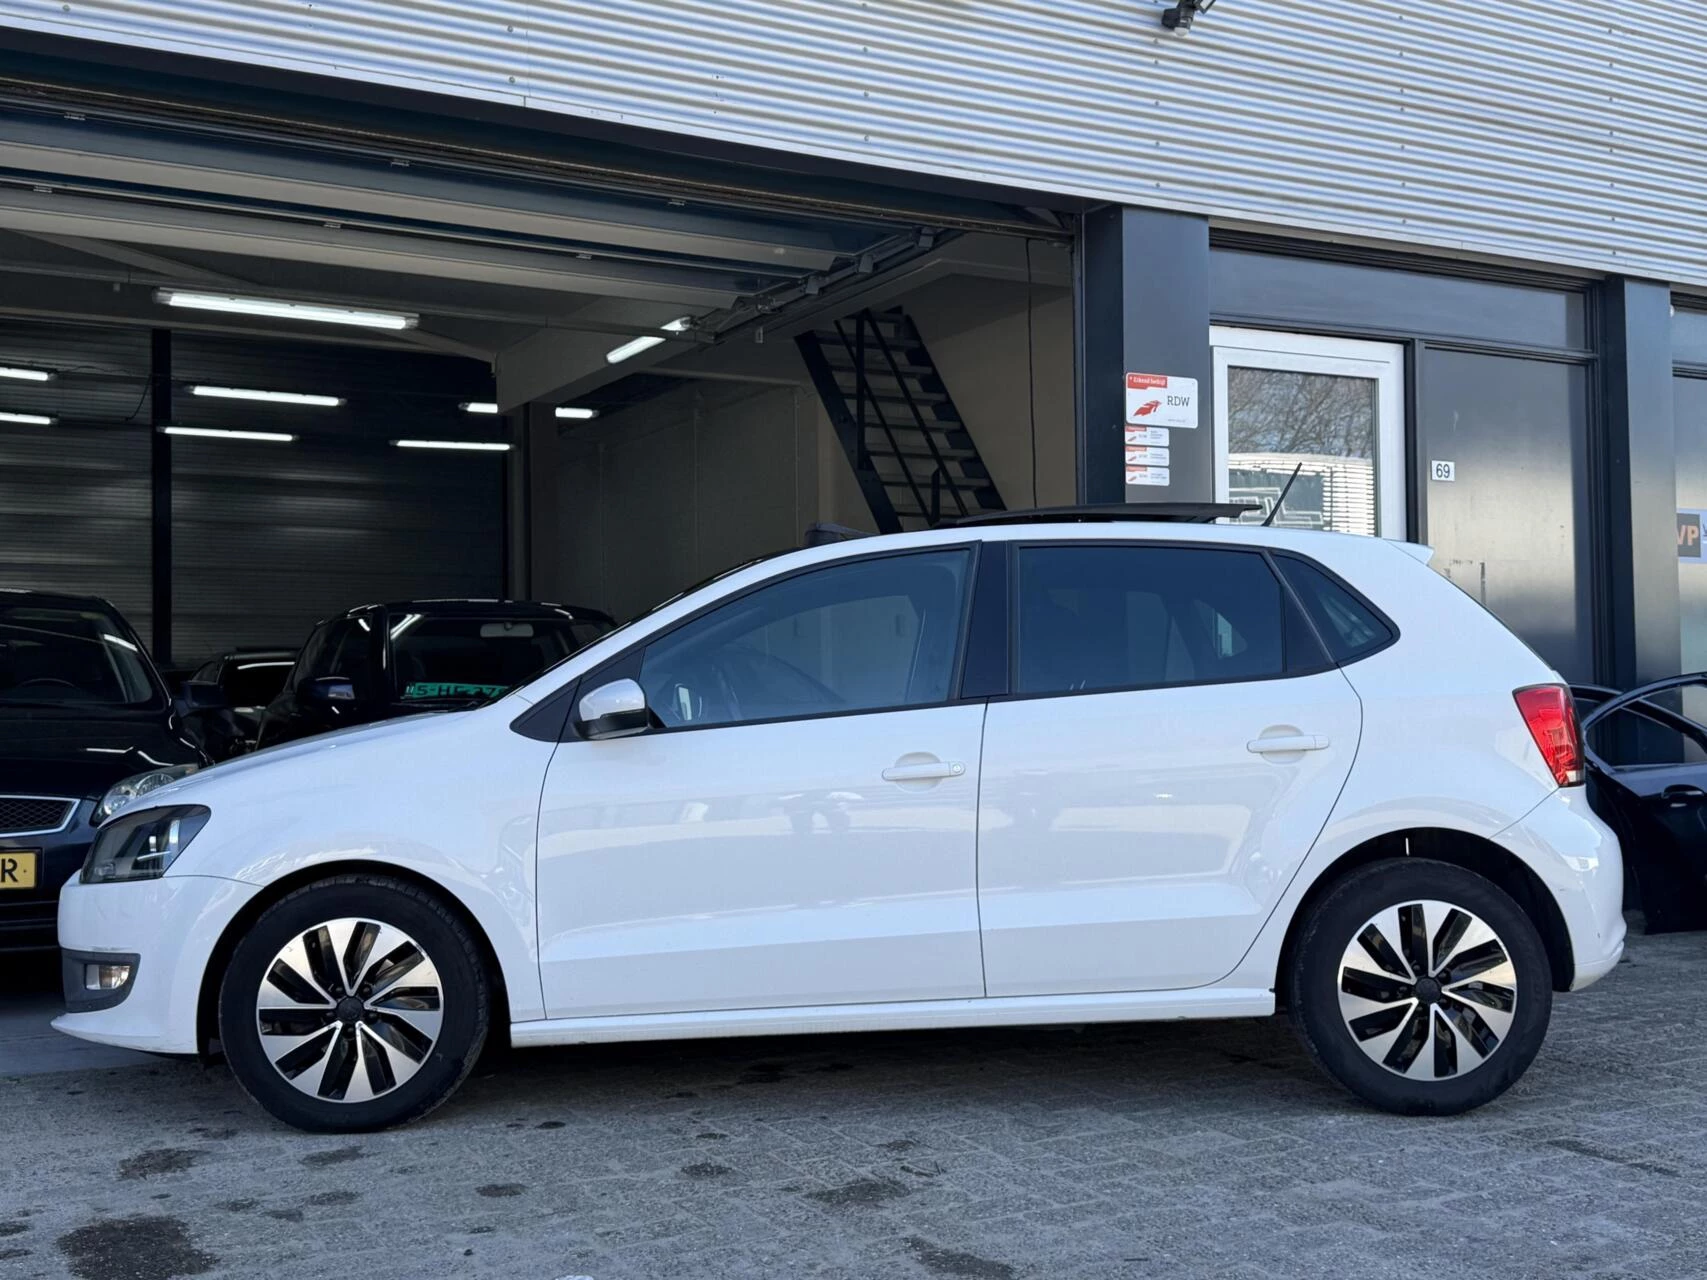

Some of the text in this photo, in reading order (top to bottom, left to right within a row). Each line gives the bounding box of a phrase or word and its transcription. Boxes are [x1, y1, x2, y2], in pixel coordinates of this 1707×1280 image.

[1167, 395, 1190, 407] RDW
[1435, 463, 1450, 478] 69
[1, 857, 19, 883] R
